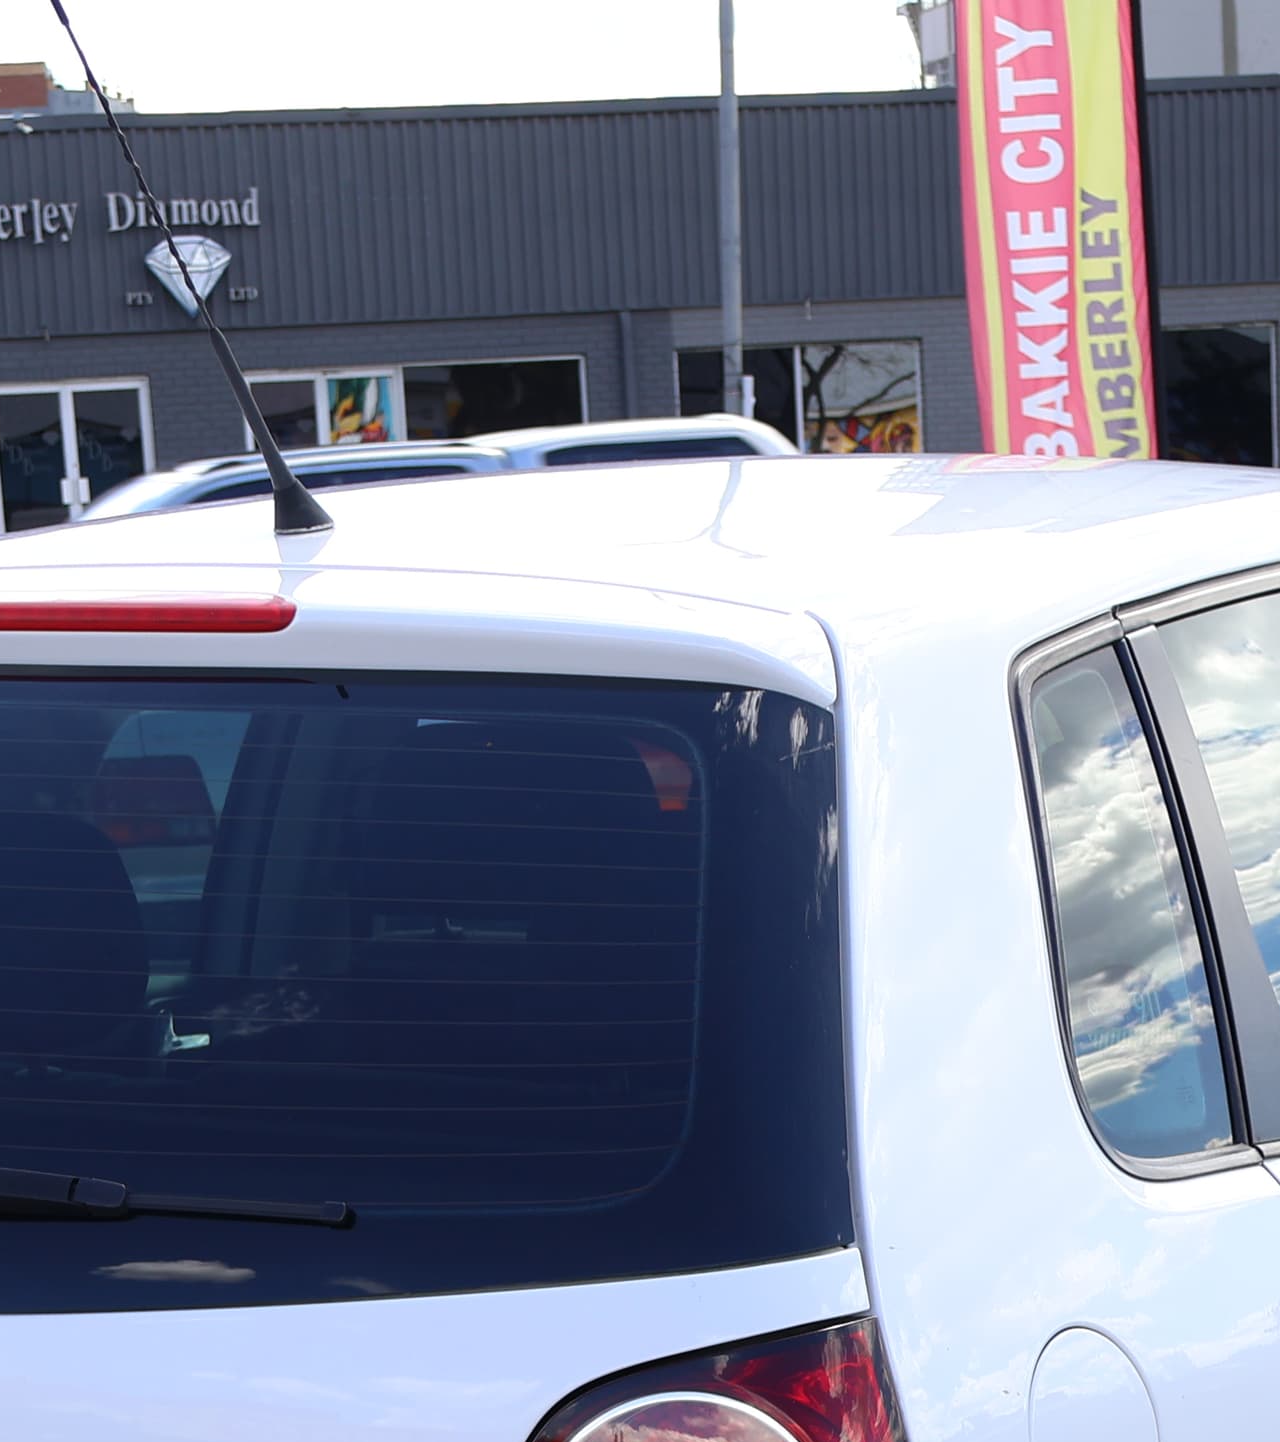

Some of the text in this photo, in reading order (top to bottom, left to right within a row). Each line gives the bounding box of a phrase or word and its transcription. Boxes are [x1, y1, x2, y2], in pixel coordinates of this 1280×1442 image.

[105, 187, 261, 233] Diamond
[993, 16, 1079, 457] BAKKIE CITY
